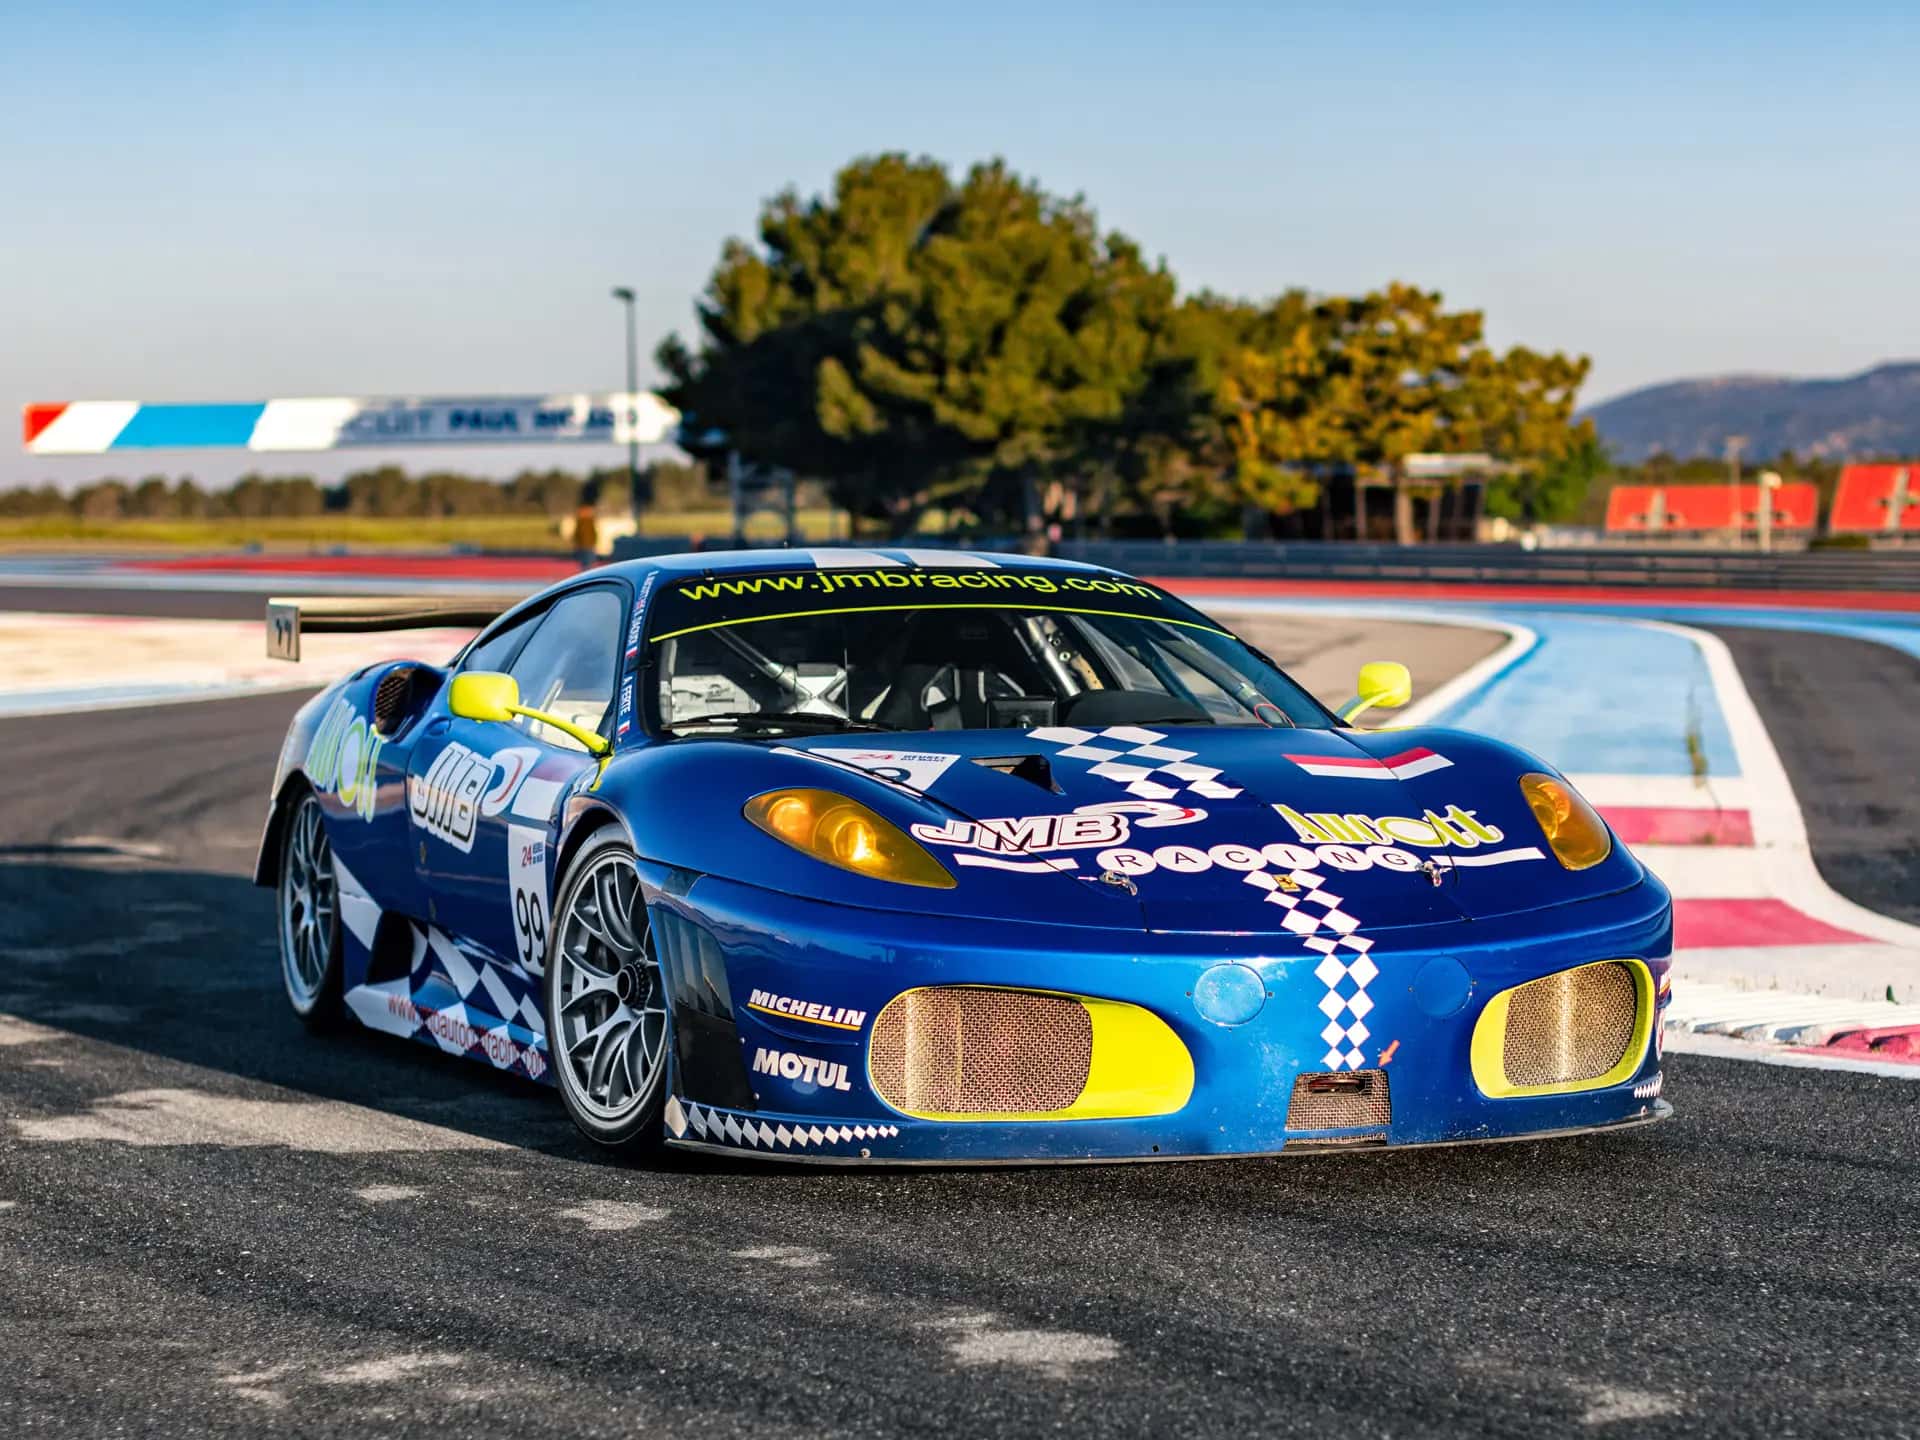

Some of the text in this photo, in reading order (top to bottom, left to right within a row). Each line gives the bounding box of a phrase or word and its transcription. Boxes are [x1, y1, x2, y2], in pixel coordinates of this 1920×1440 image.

[680, 570, 1162, 600] www.jmbracing.com
[411, 741, 491, 854] JMB
[910, 813, 1130, 856] JMB
[521, 845, 533, 868] 24
[1110, 849, 1415, 871] RACING
[516, 887, 547, 968] 99
[749, 988, 867, 1026] MICHELIN
[752, 1047, 852, 1092] MOTUL
